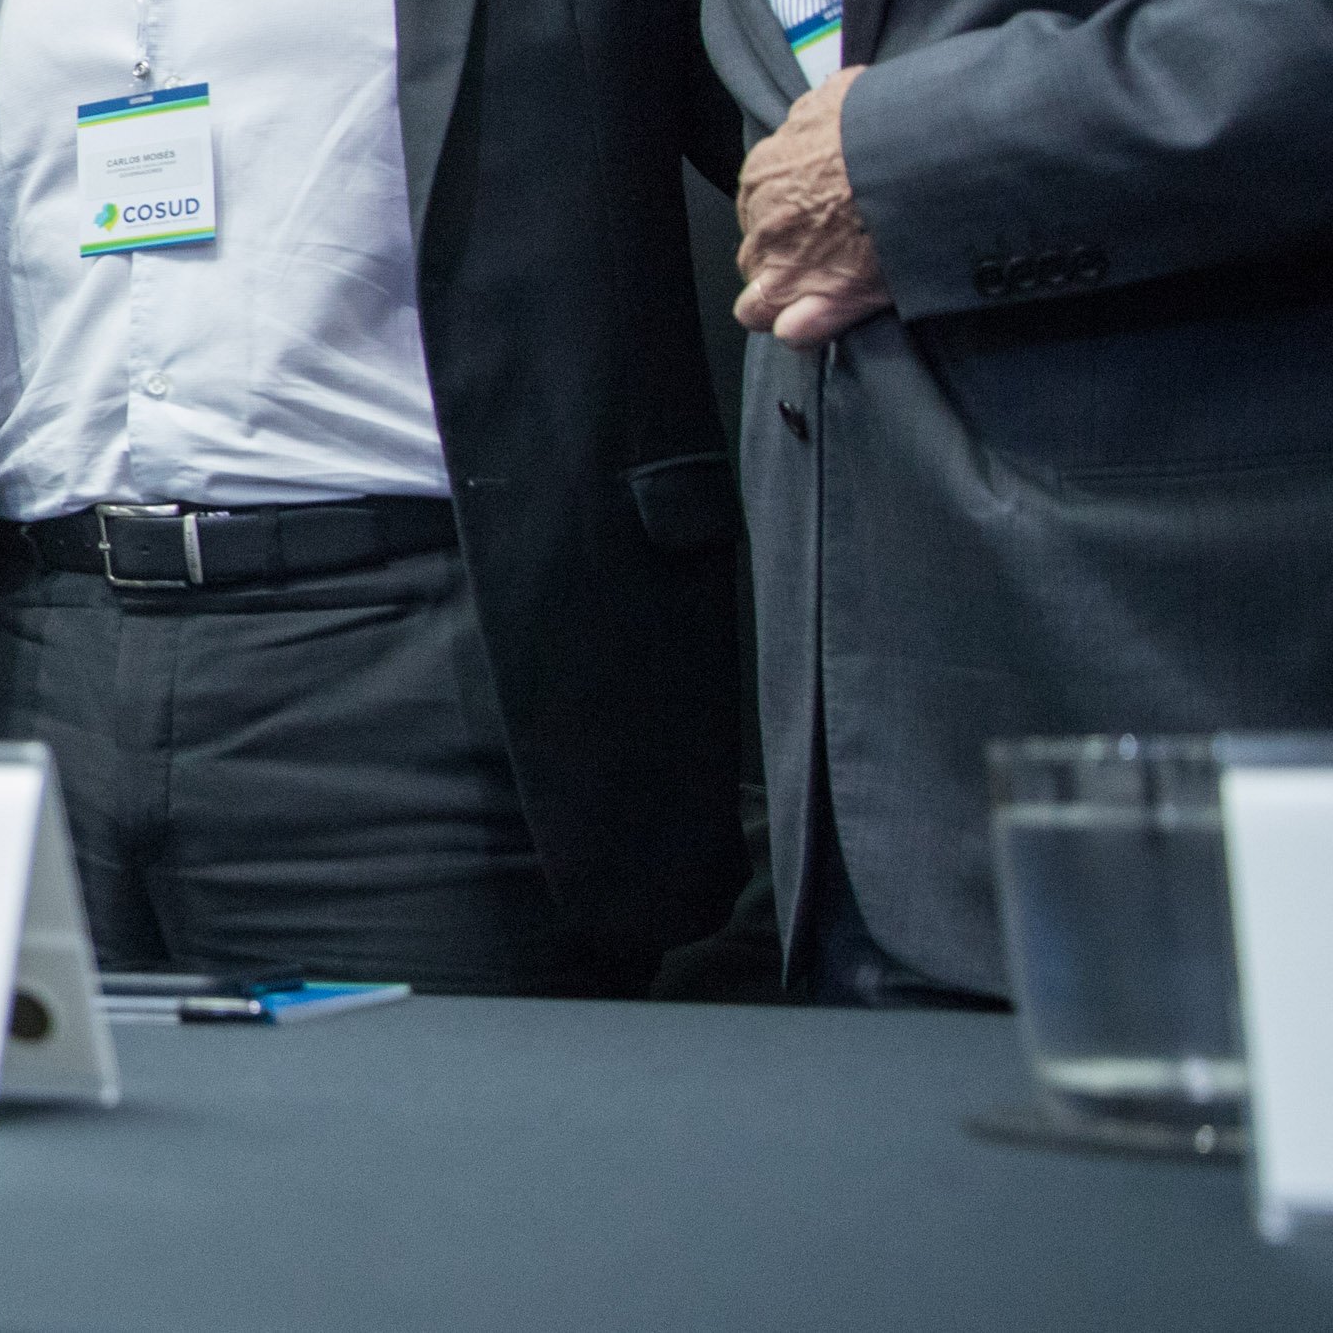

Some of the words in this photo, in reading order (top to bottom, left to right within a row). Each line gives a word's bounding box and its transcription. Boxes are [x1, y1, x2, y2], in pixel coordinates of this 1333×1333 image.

[106, 156, 140, 168] CARLOS
[143, 149, 176, 162] MOISÉS
[123, 198, 200, 223] COSUD
